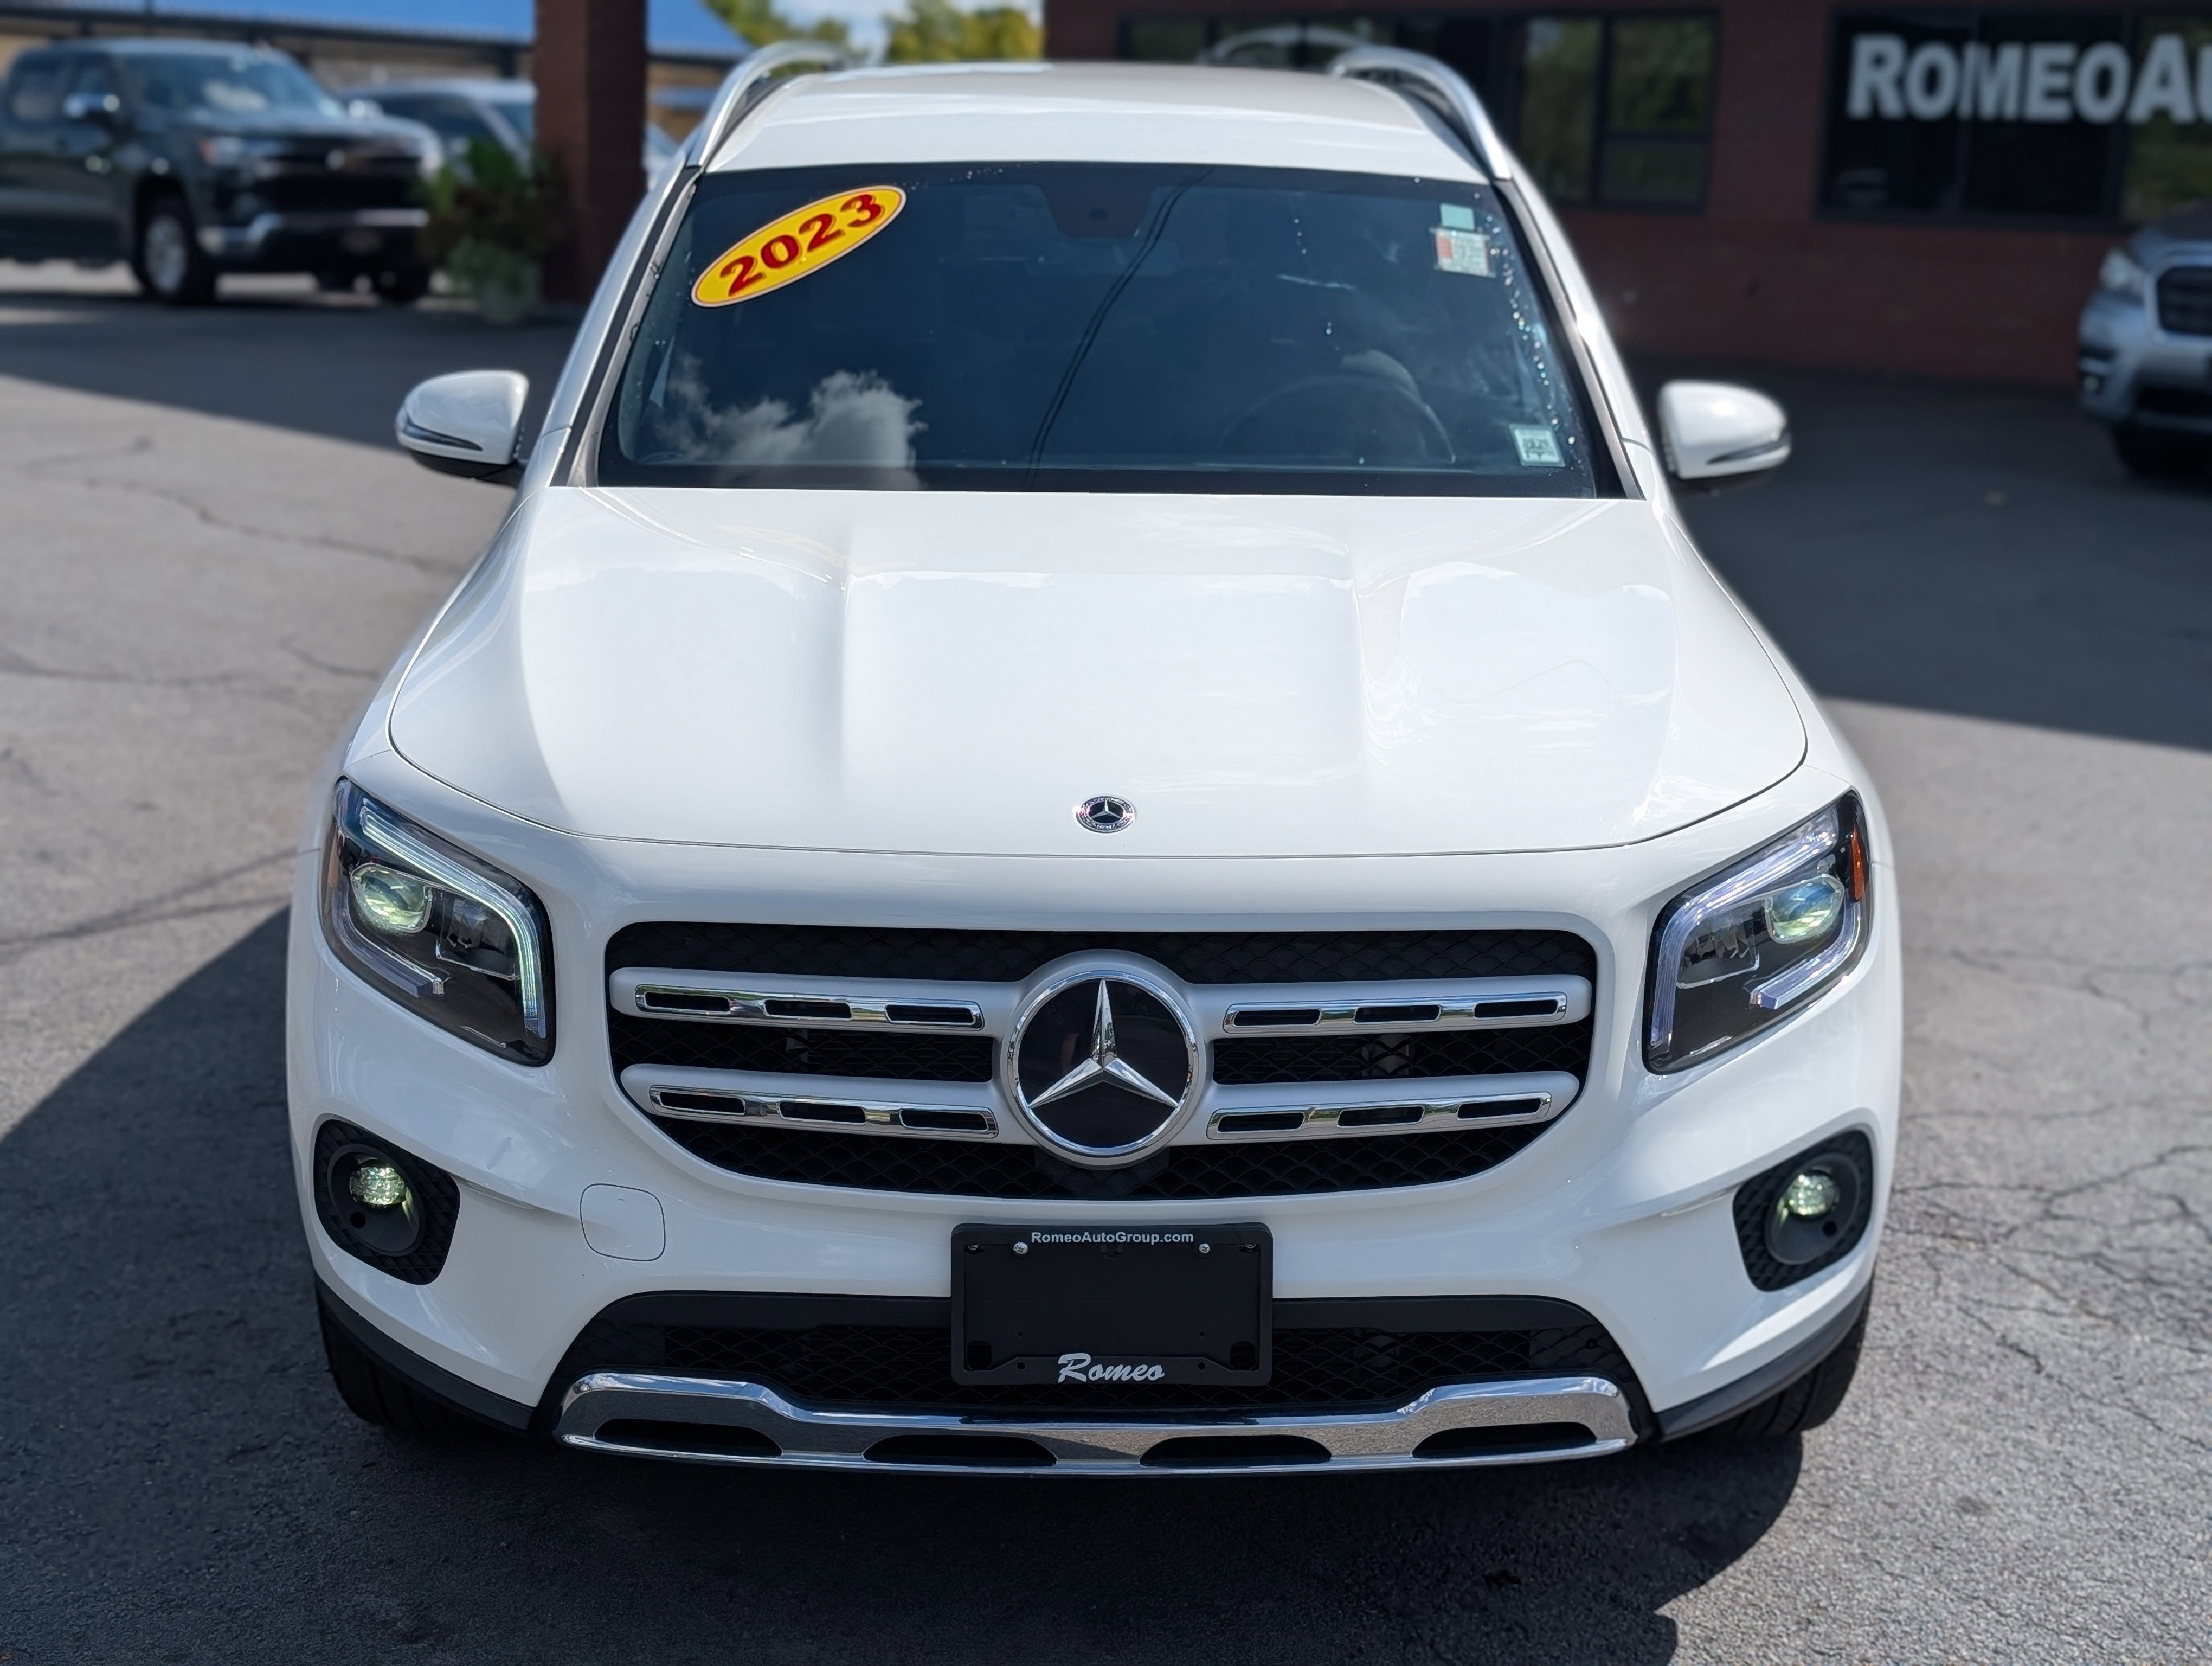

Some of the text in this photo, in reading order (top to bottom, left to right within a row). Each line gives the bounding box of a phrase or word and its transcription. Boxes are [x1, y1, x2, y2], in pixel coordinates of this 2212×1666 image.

[719, 194, 885, 297] 2023
[1031, 1232, 1194, 1245] RomeoAutoGroup.com
[1057, 1353, 1165, 1383] Romeo
